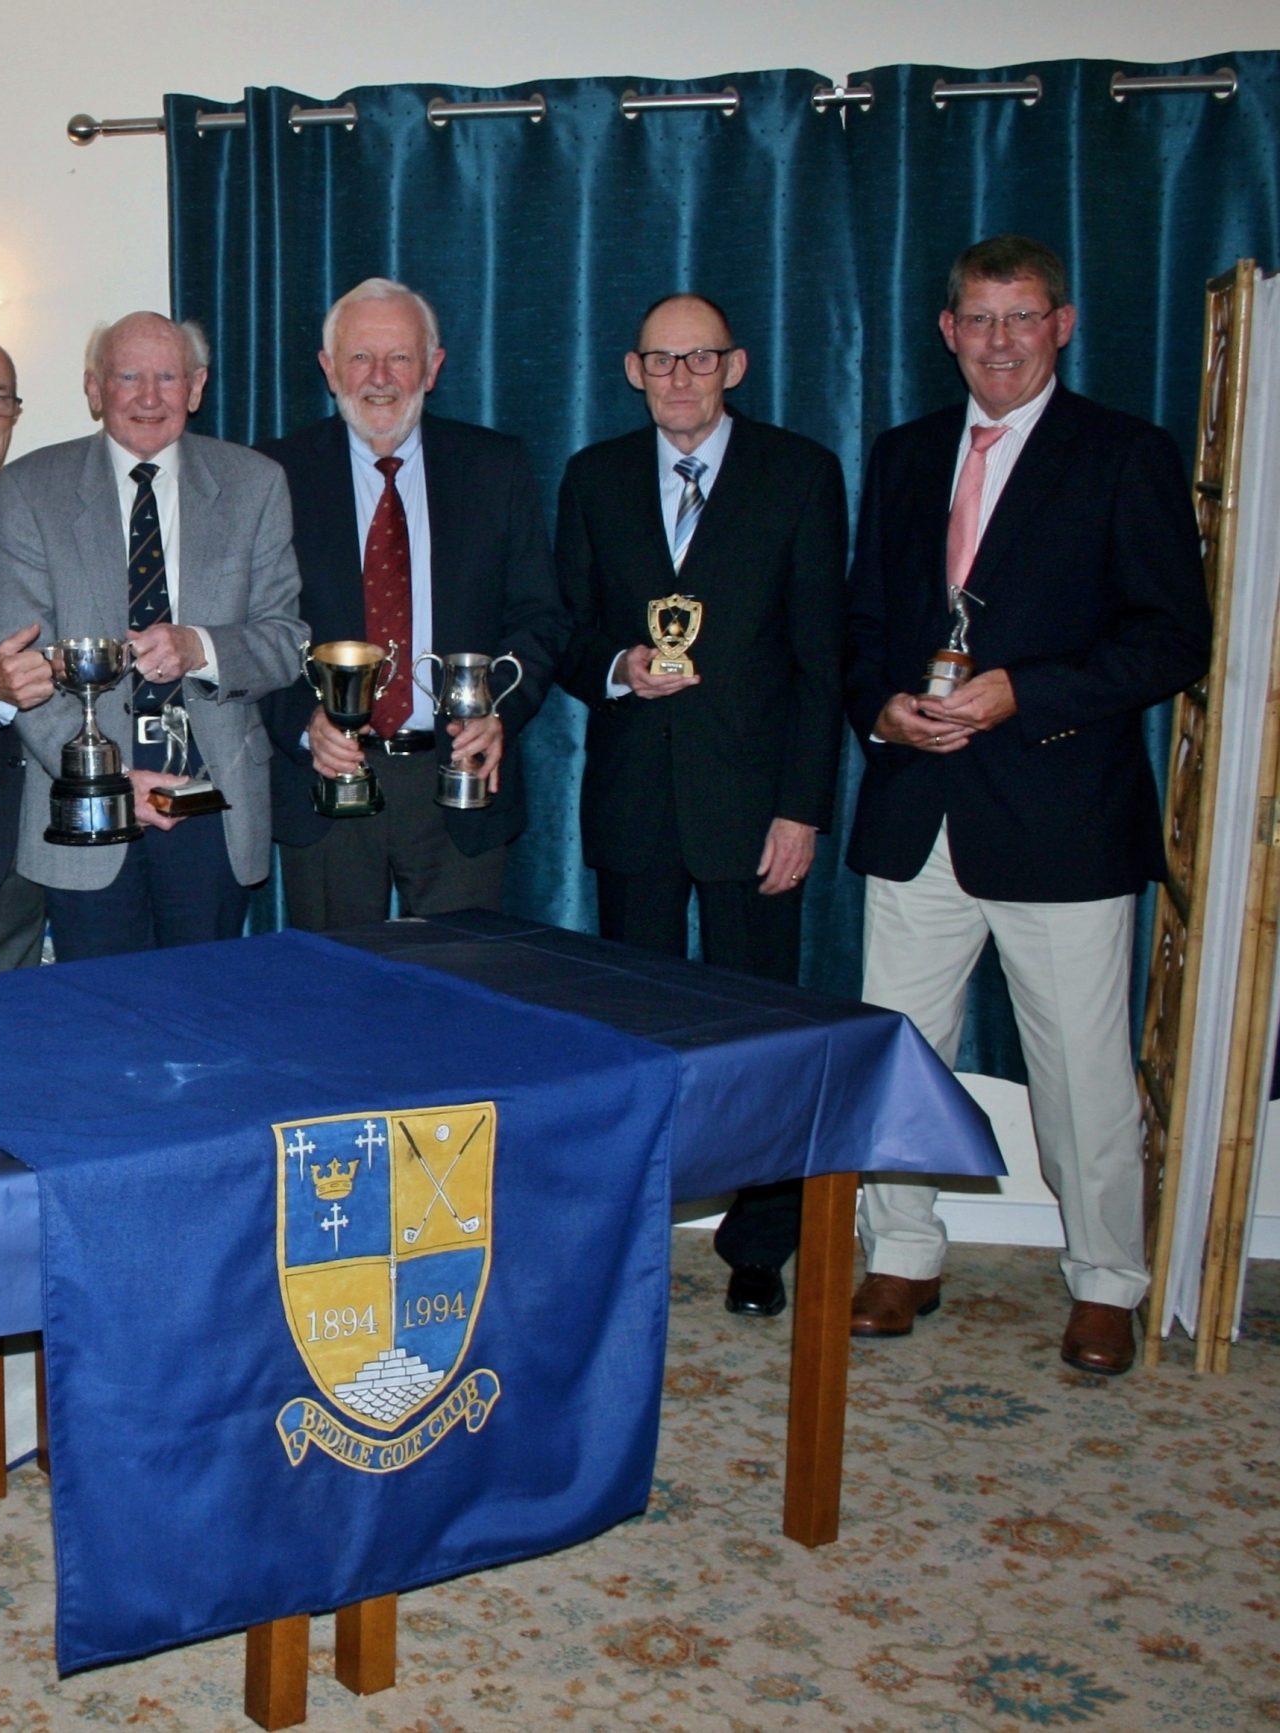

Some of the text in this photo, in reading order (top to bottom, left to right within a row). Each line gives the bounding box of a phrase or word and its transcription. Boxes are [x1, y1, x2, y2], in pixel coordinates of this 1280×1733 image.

[306, 1305, 379, 1342] 1894
[403, 1291, 467, 1329] 1994
[300, 1378, 479, 1468] BEDALE GOLF CLUB
